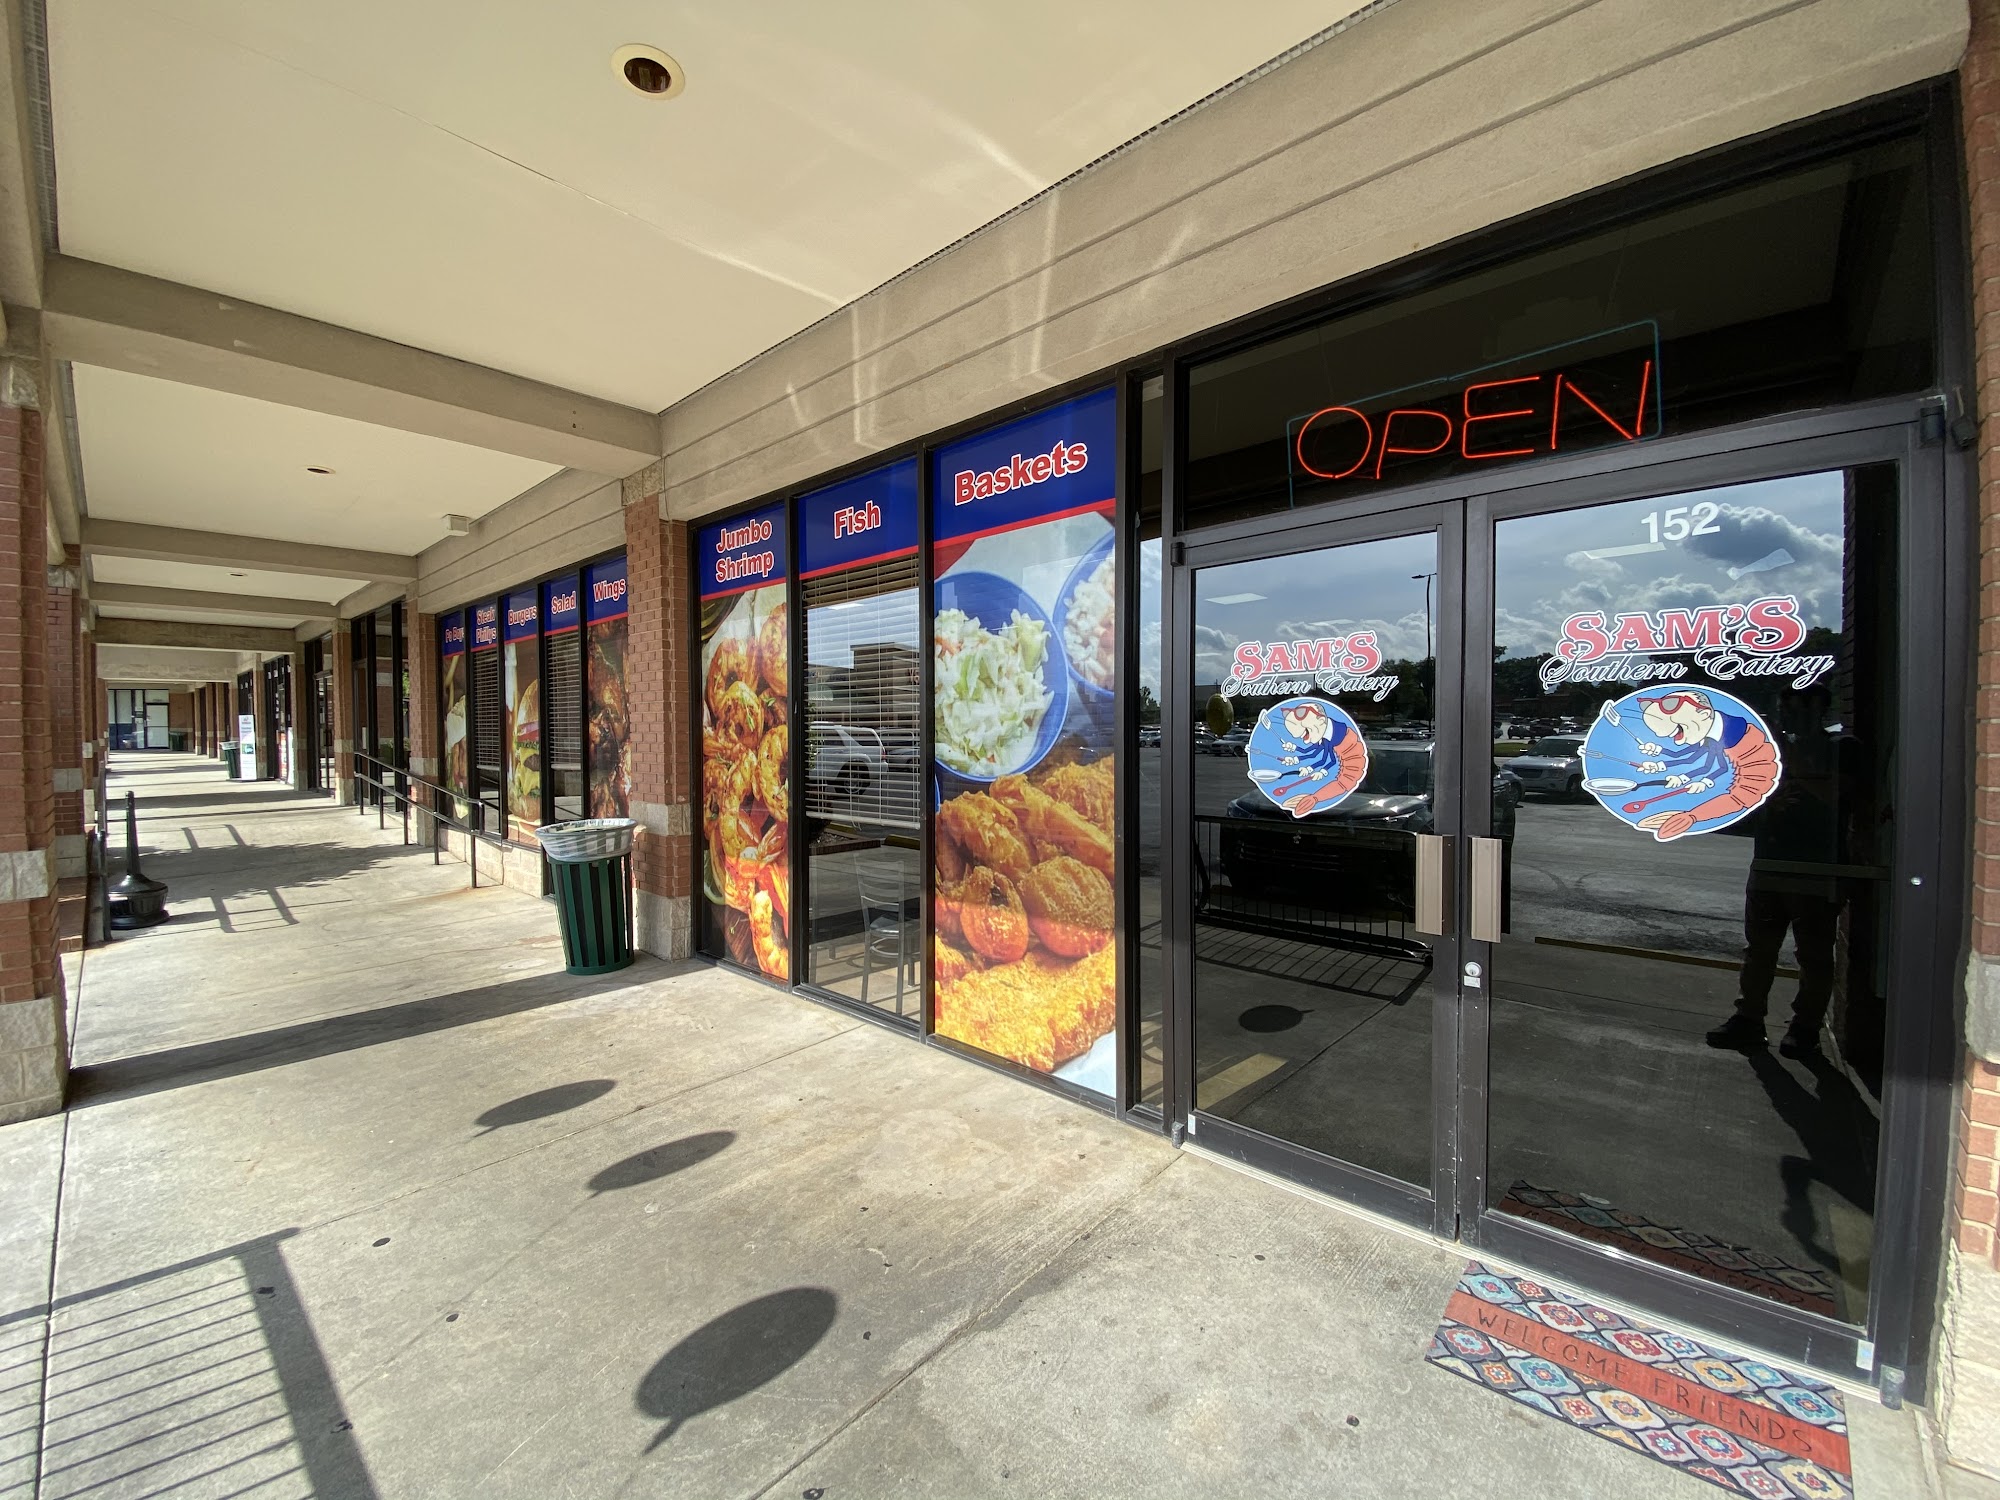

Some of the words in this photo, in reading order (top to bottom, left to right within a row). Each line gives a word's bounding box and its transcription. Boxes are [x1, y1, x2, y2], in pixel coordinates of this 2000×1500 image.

[1297, 360, 1652, 480] OPEN
[954, 440, 1088, 505] Baskets
[716, 518, 773, 554] Jumbo
[833, 500, 882, 539] Fish
[1641, 501, 1721, 544] 152
[716, 550, 775, 582] Shrimp
[551, 590, 576, 615] Salad
[593, 578, 627, 602] Wings
[477, 607, 495, 625] Steak
[508, 606, 537, 626] Burgers
[1555, 594, 1807, 664] SAM'S
[476, 626, 496, 644] Phillys
[1230, 629, 1382, 683] SAM'S
[1538, 651, 1688, 690] Southern
[1694, 644, 1836, 690] Eatery
[1220, 673, 1311, 702] Southern
[1315, 668, 1399, 702] Eatery
[1477, 1306, 1638, 1384] WELCOME
[1653, 1377, 1814, 1454] FRIENDS
